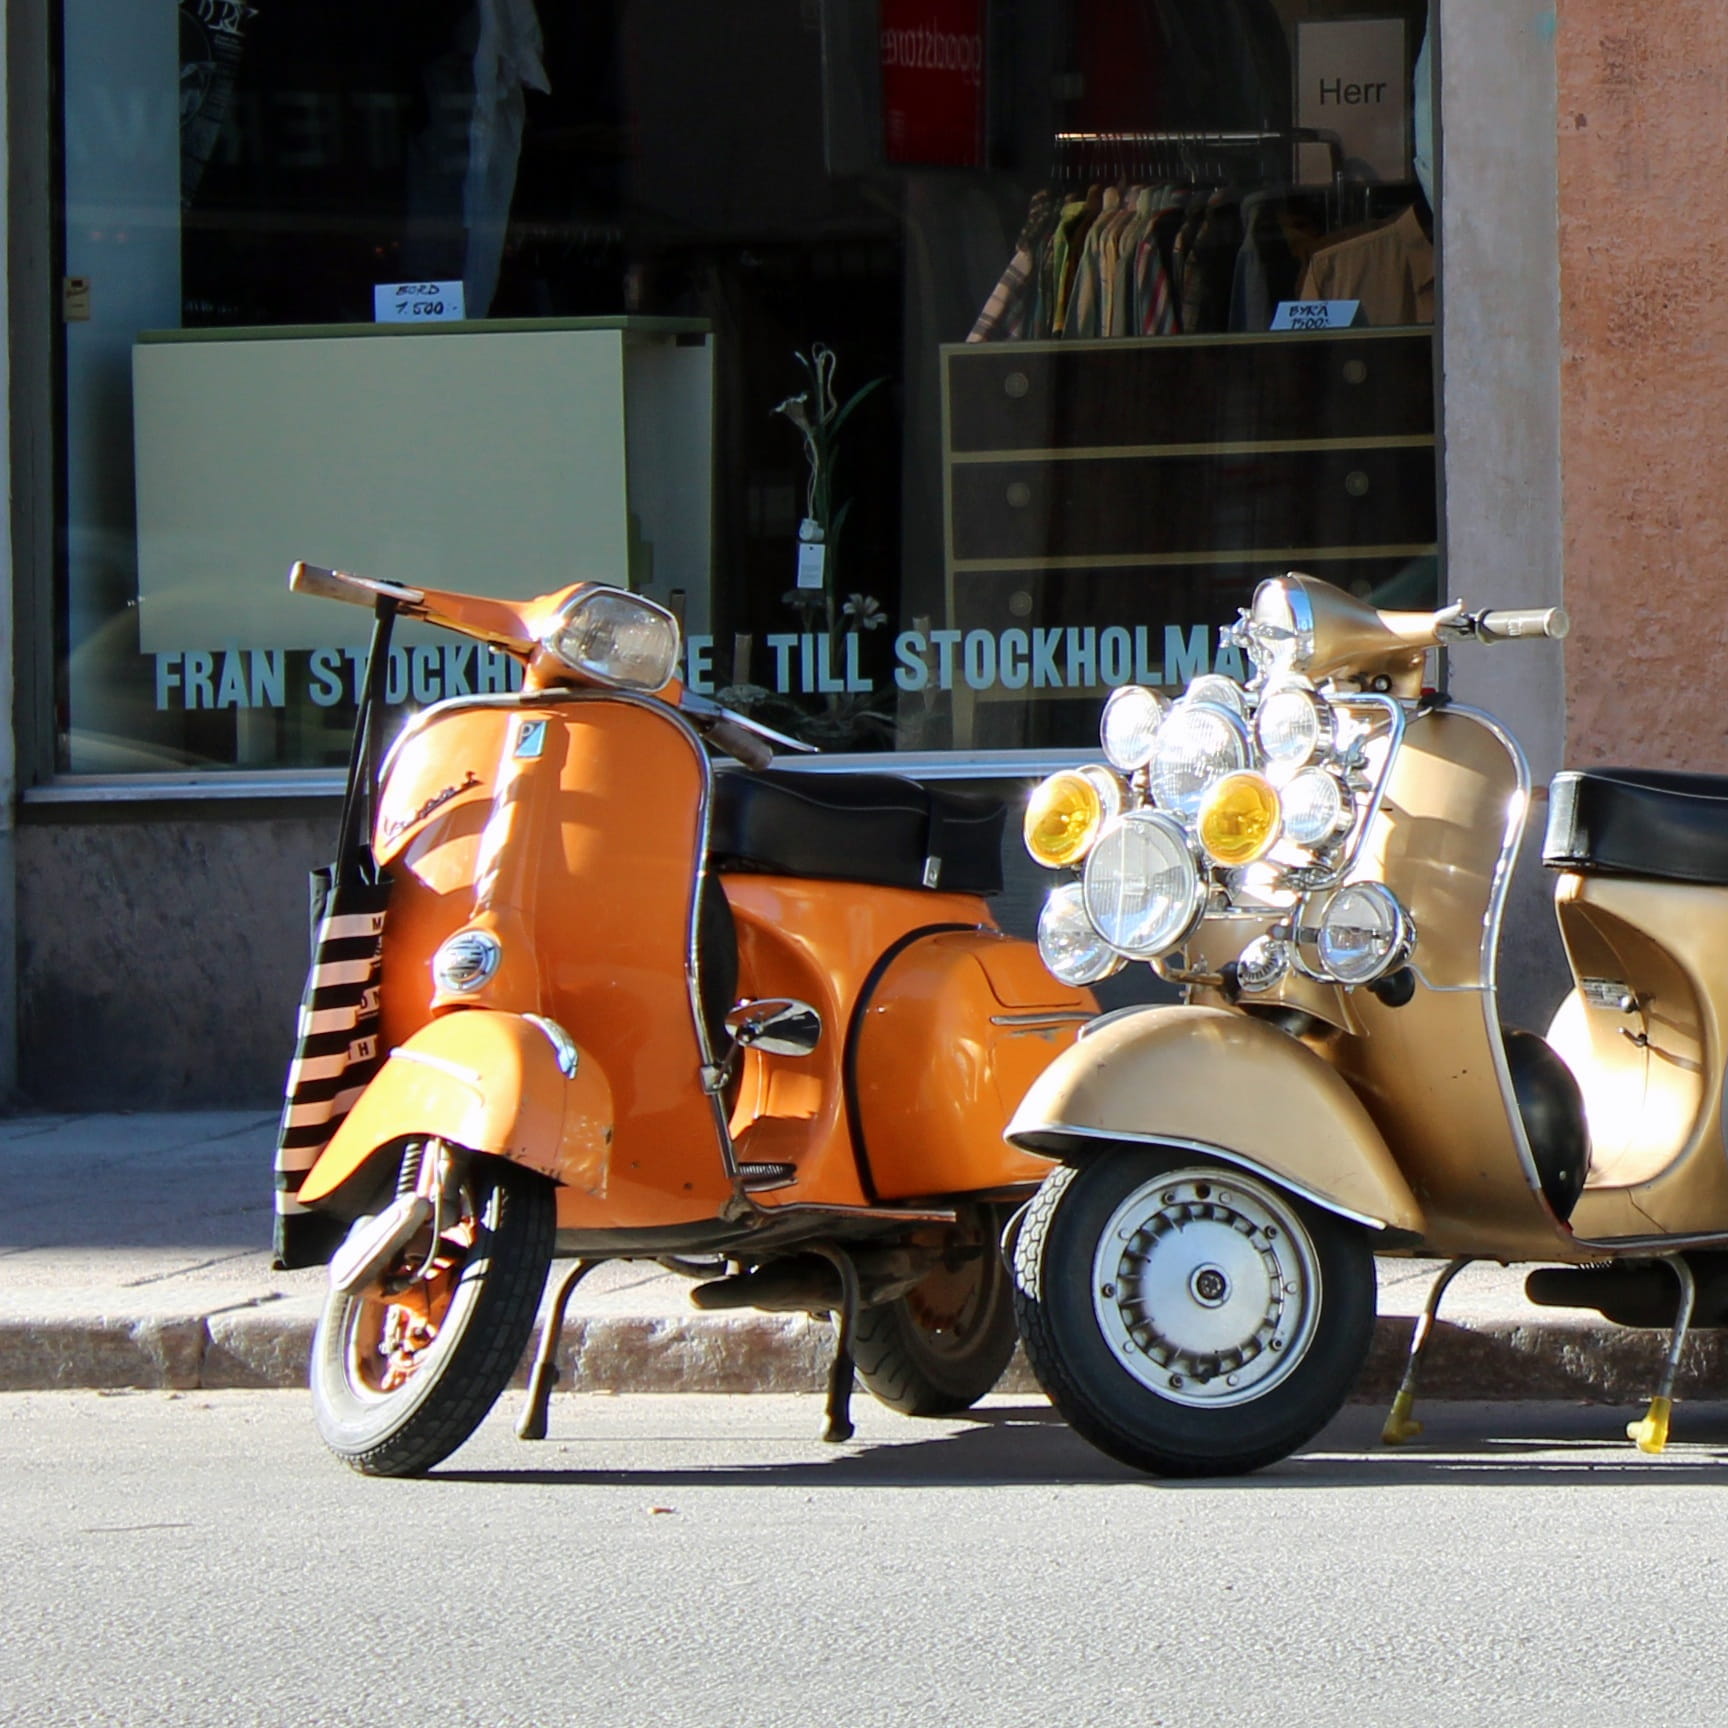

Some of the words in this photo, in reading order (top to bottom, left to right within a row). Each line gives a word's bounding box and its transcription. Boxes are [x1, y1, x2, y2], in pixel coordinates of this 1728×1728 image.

[1319, 77, 1388, 105] Herr
[155, 635, 286, 710] FRÅN
[767, 632, 873, 694] TILL
[894, 624, 1257, 692] STOCKHOLMA
